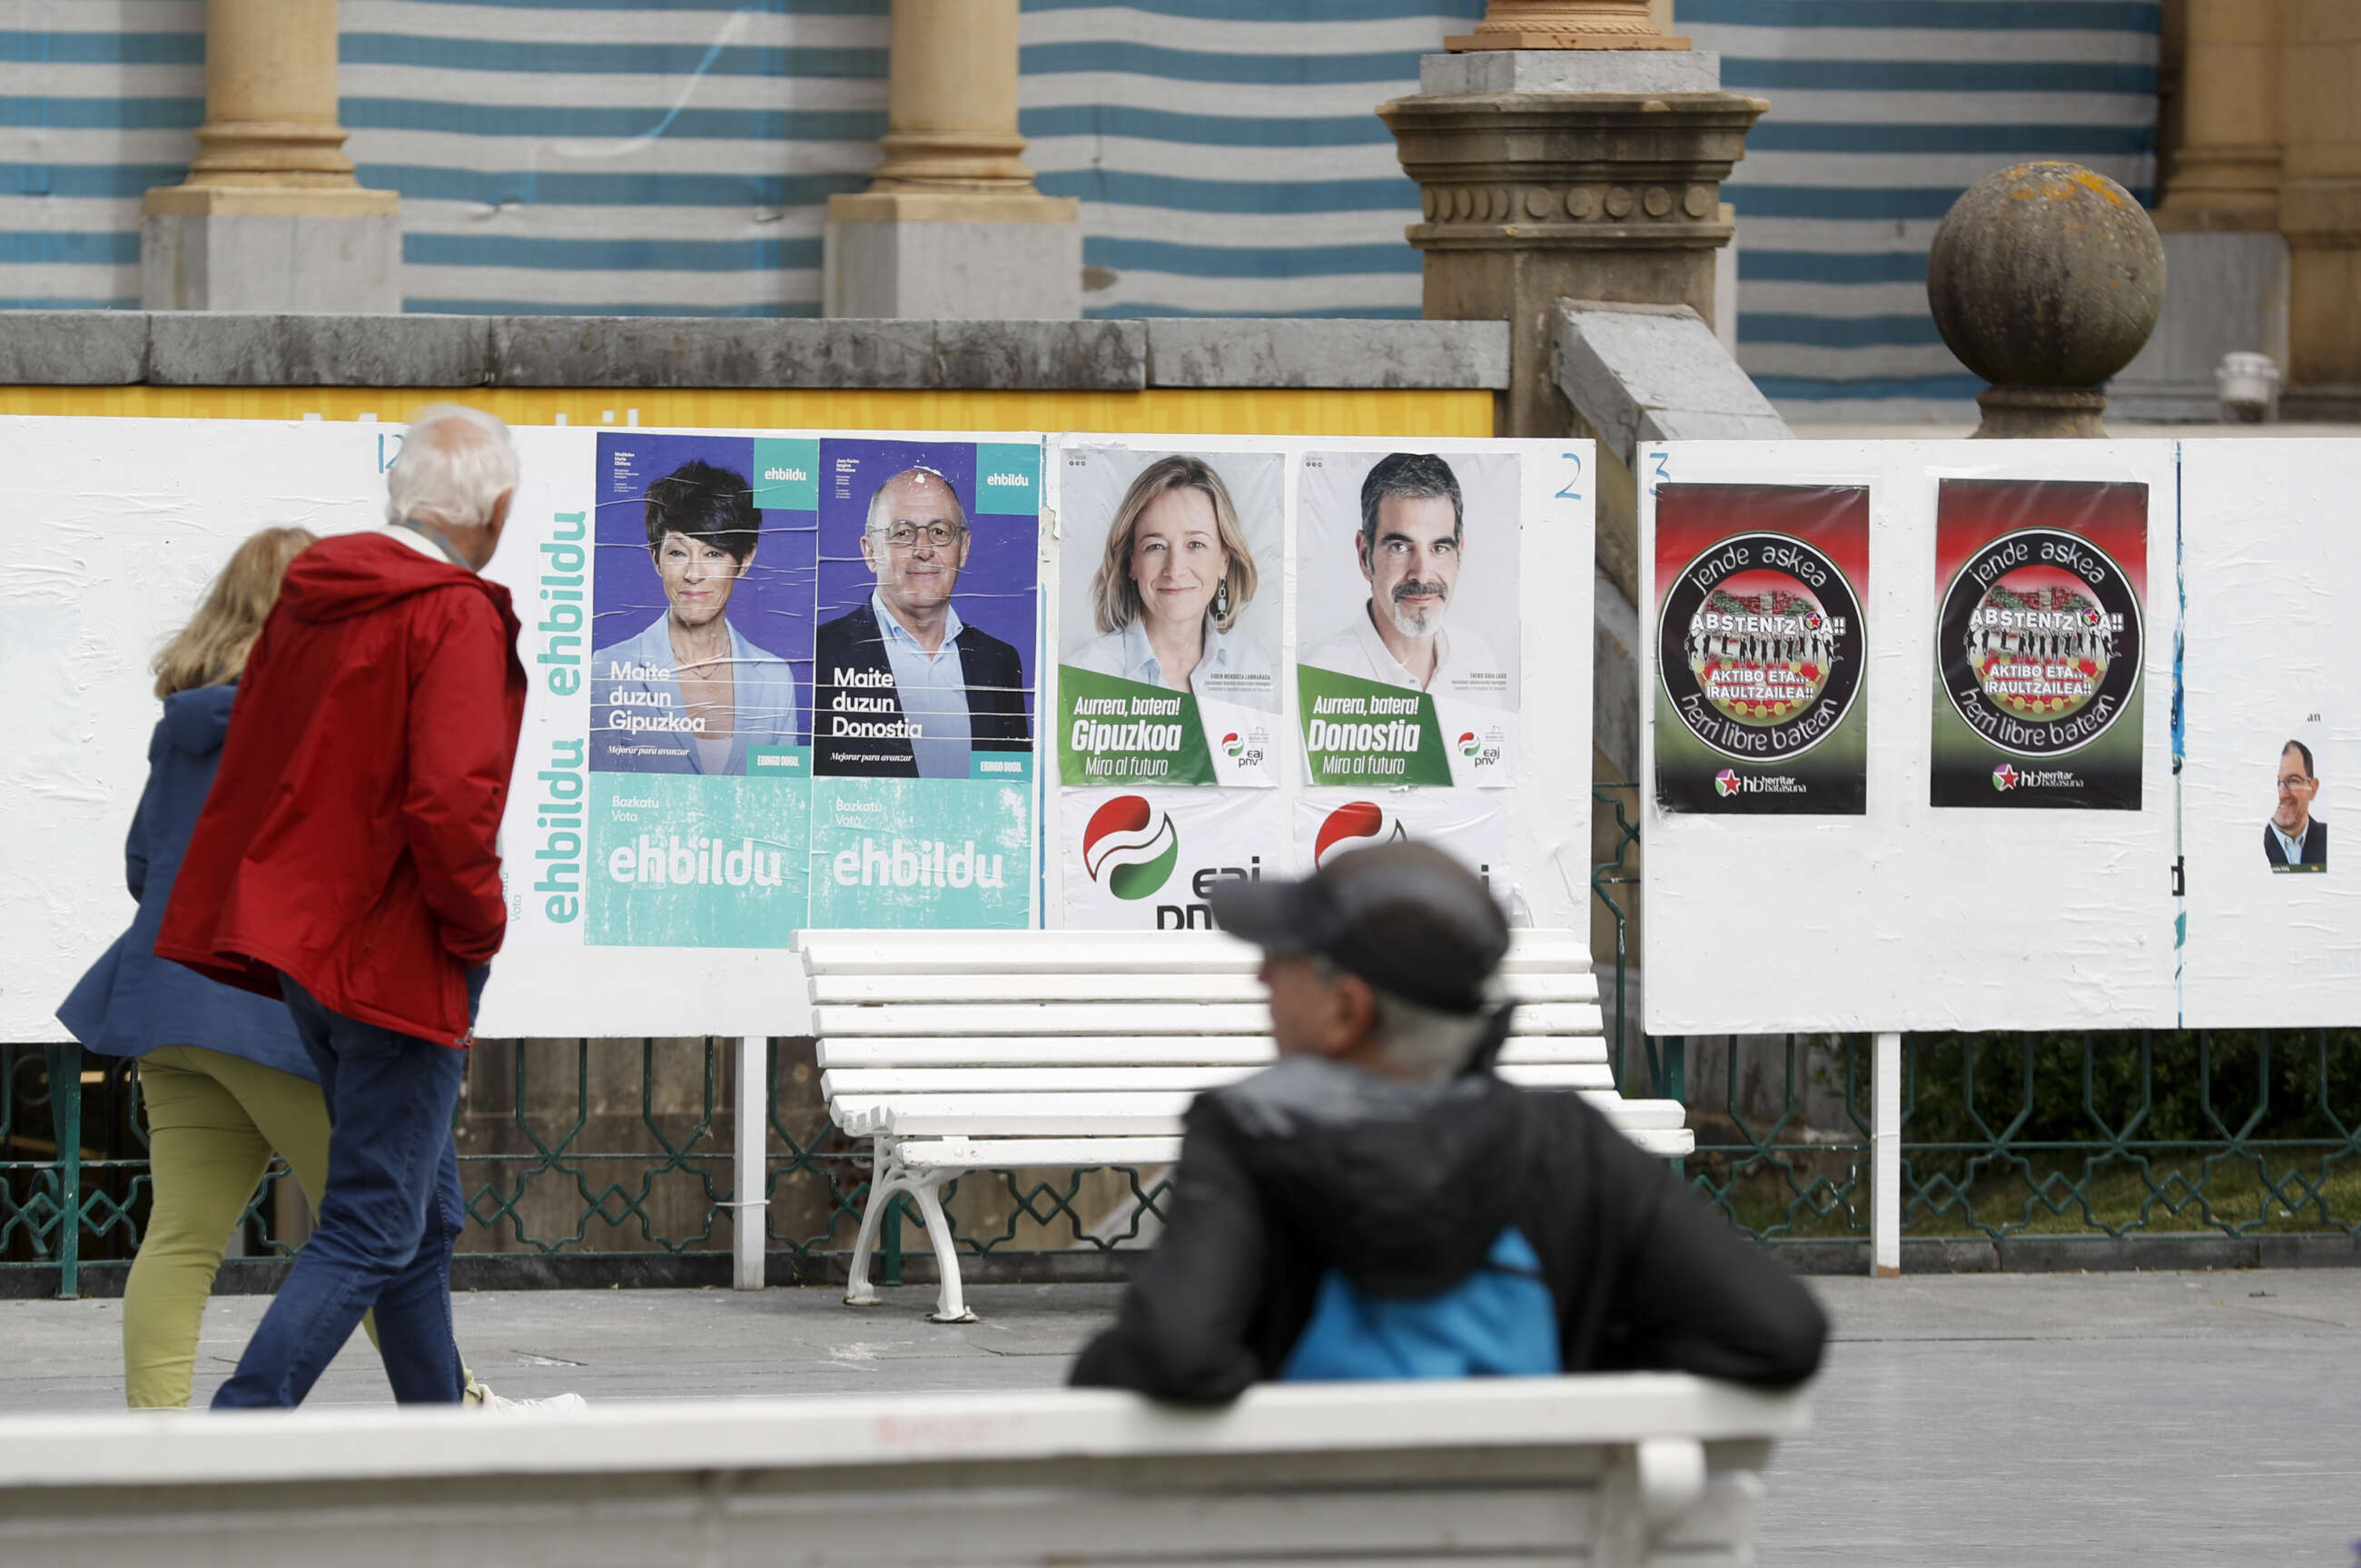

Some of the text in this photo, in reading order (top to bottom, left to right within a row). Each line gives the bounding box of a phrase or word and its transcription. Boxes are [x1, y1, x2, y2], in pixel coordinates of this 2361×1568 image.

[765, 468, 806, 481] ehbildu
[987, 473, 1029, 487] ehbildu
[1555, 453, 1582, 500] 2
[1649, 453, 1671, 497] 3
[1688, 546, 1827, 596] jende askea
[1969, 541, 2106, 590] jende askea
[537, 511, 586, 696] ehbildu
[611, 661, 671, 681] Maite
[834, 667, 894, 687] Maite
[1710, 669, 1764, 683] AKTIBO
[1990, 665, 2042, 678] AKTIBO
[609, 685, 671, 706] duzun
[1706, 685, 1814, 699] IRAULTZAILEA!!
[1984, 681, 2092, 695] IRAULTZAILEA!!
[832, 691, 895, 712] duzun
[1073, 695, 1180, 717] Aurrera, batera!
[1312, 695, 1419, 716] Aurrera, batera!
[608, 710, 706, 735] Gipuzkoa
[1682, 693, 1838, 751] herri libre batean
[1960, 687, 2116, 746] herri libre batean
[832, 716, 923, 738] Donostia
[1072, 719, 1182, 755] Gipuzkoa
[1308, 719, 1421, 752] Donostia
[608, 745, 689, 756] Mejorar para avanzar
[831, 752, 914, 763] Mejorar para avanzar
[1248, 748, 1263, 761] eaj
[1483, 745, 1500, 759] eaj
[1085, 756, 1169, 776] Mira al futuro
[1239, 757, 1259, 768] pnv
[1322, 754, 1406, 774] Mira al futuro
[1475, 756, 1496, 767] pnv
[1743, 776, 1763, 793] hb
[2020, 771, 2041, 787] hb
[612, 795, 659, 808] Bozkatu
[835, 797, 883, 813] Bozkatu
[611, 810, 638, 822] Vota
[835, 814, 861, 826] Vota
[534, 738, 584, 923] ehbildu
[608, 834, 783, 886] ehbildu
[833, 838, 1005, 889] ehbildu
[510, 894, 522, 922] Vota
